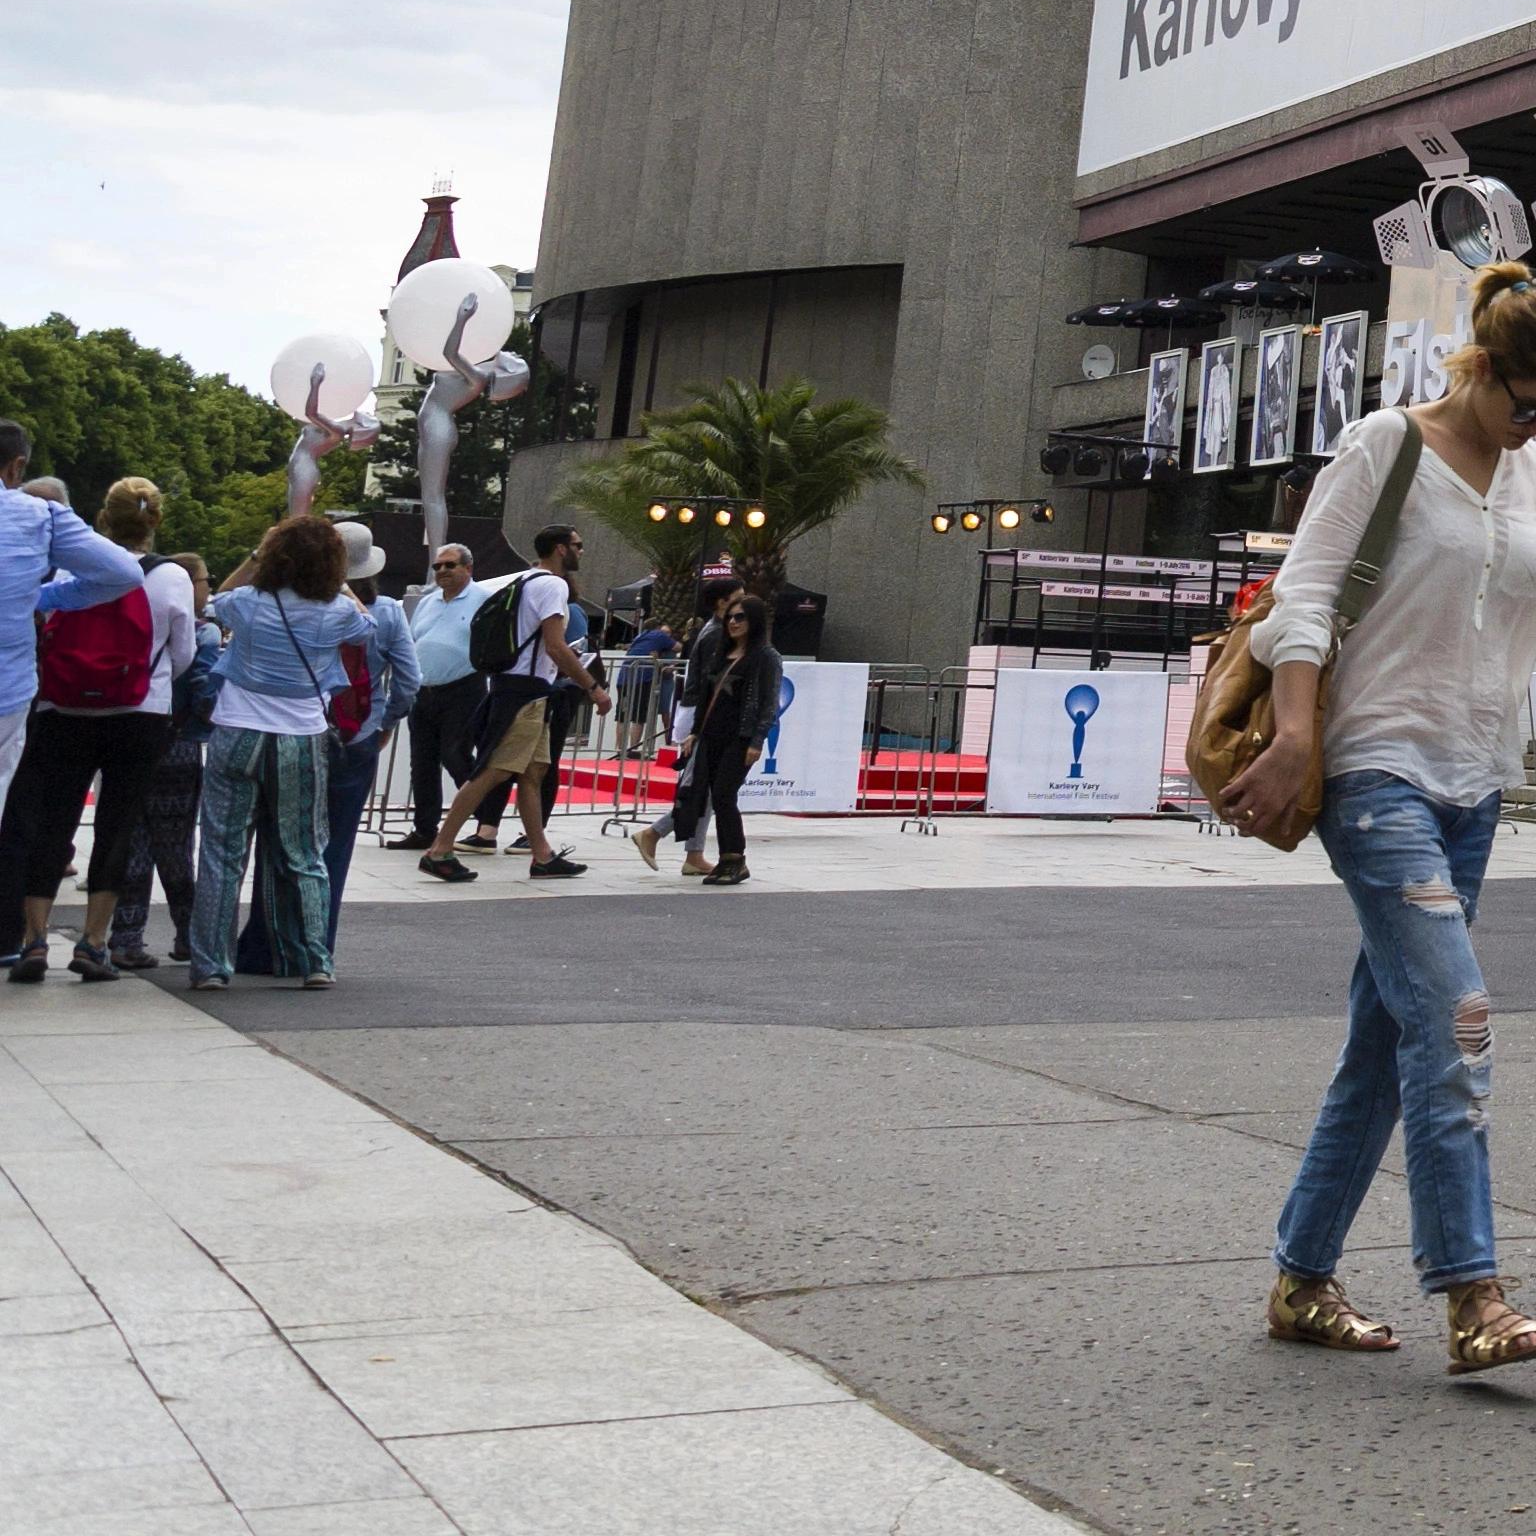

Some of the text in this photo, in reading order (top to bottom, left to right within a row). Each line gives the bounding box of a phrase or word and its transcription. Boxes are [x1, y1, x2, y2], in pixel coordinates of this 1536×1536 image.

[776, 778, 795, 787] Vary
[1049, 781, 1100, 791] Karlovy Vary
[786, 788, 816, 797] Festival
[1027, 791, 1120, 800] International Film Festival
